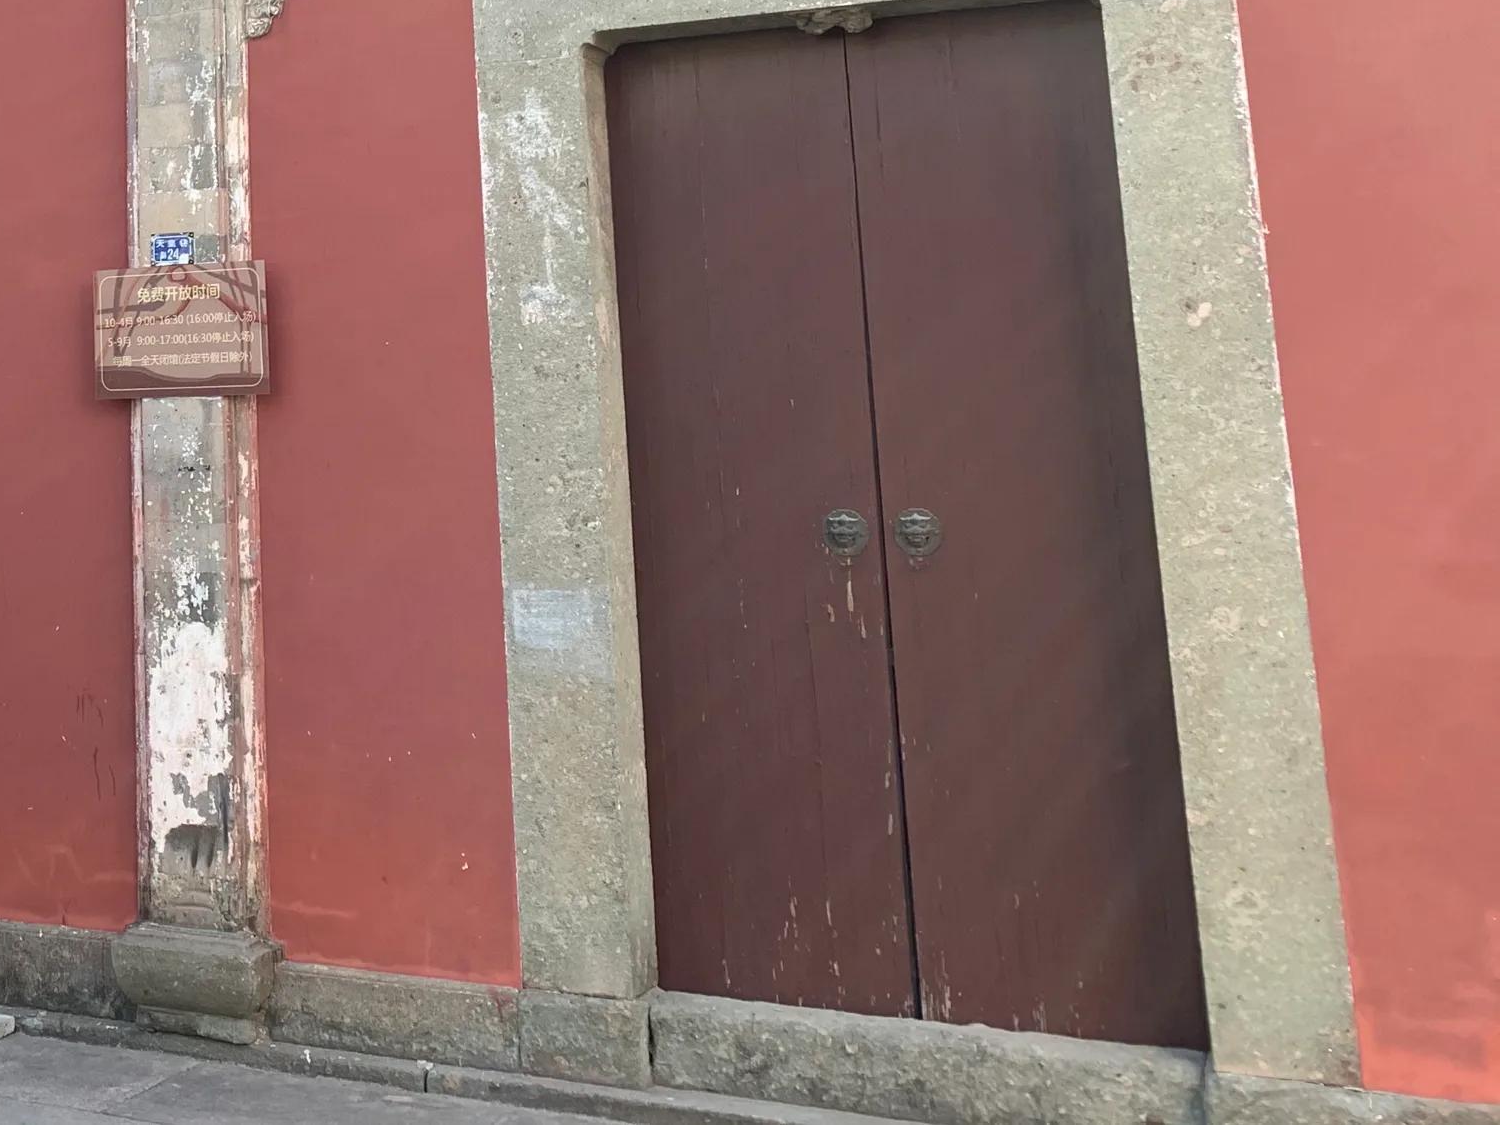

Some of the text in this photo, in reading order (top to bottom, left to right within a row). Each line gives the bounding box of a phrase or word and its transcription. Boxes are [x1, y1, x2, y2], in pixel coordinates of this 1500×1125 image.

[167, 248, 179, 260] 24
[137, 283, 220, 302] 免费开放时间
